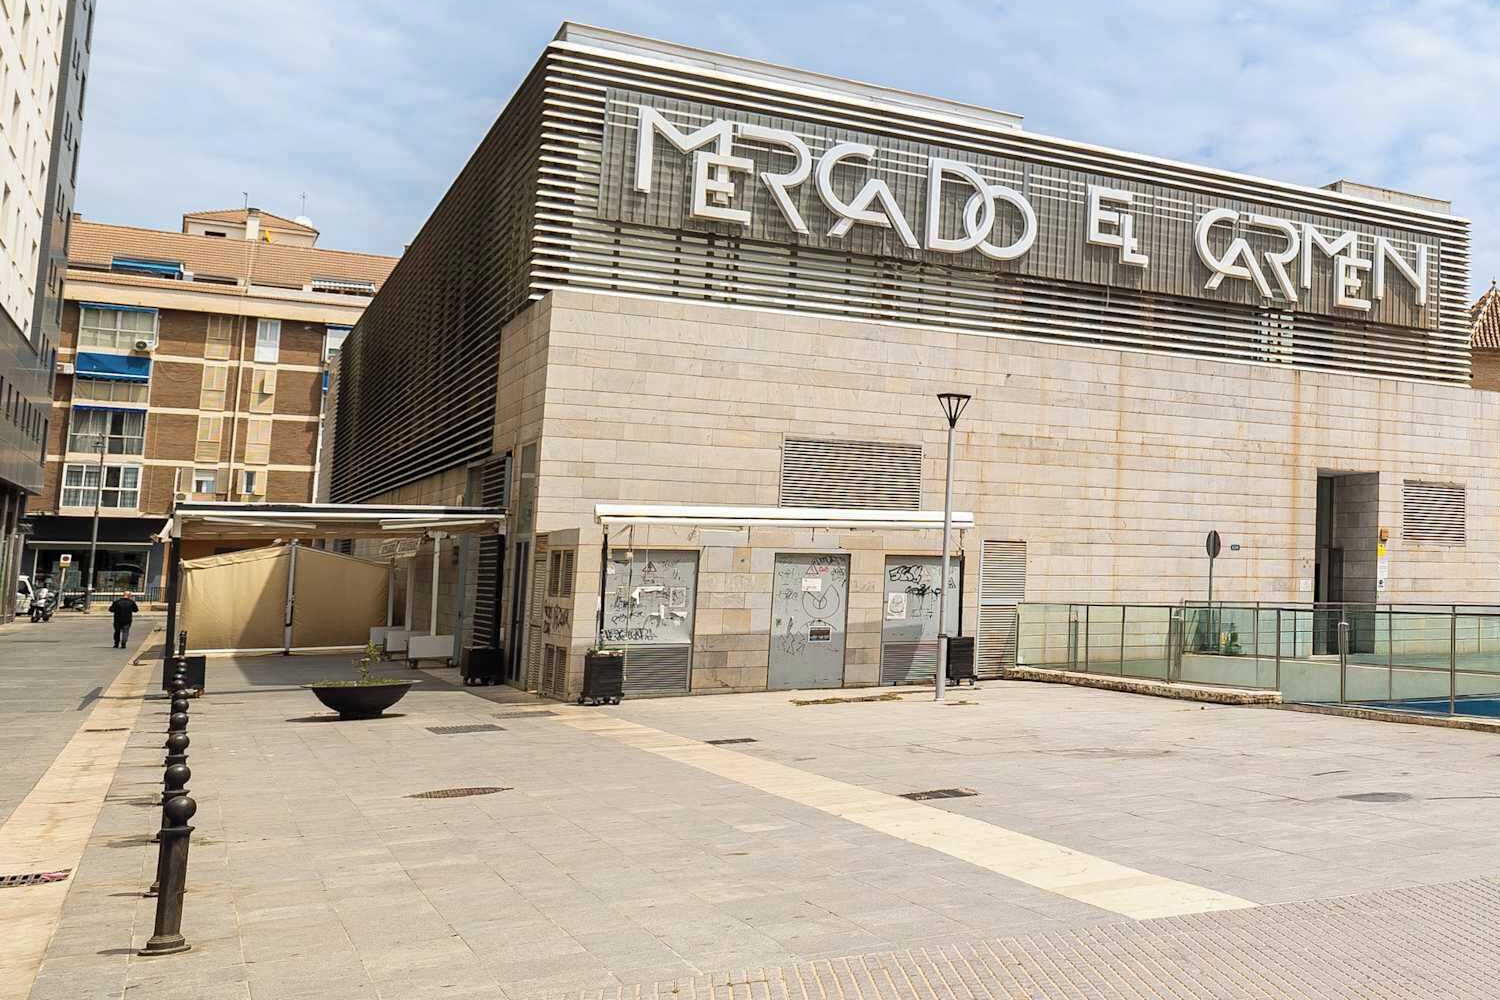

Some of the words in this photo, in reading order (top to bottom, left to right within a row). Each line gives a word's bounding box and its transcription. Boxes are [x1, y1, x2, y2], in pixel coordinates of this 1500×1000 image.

[634, 105, 1037, 261] MERCADO
[1086, 184, 1148, 268] EL
[1195, 207, 1427, 312] CARMEN
